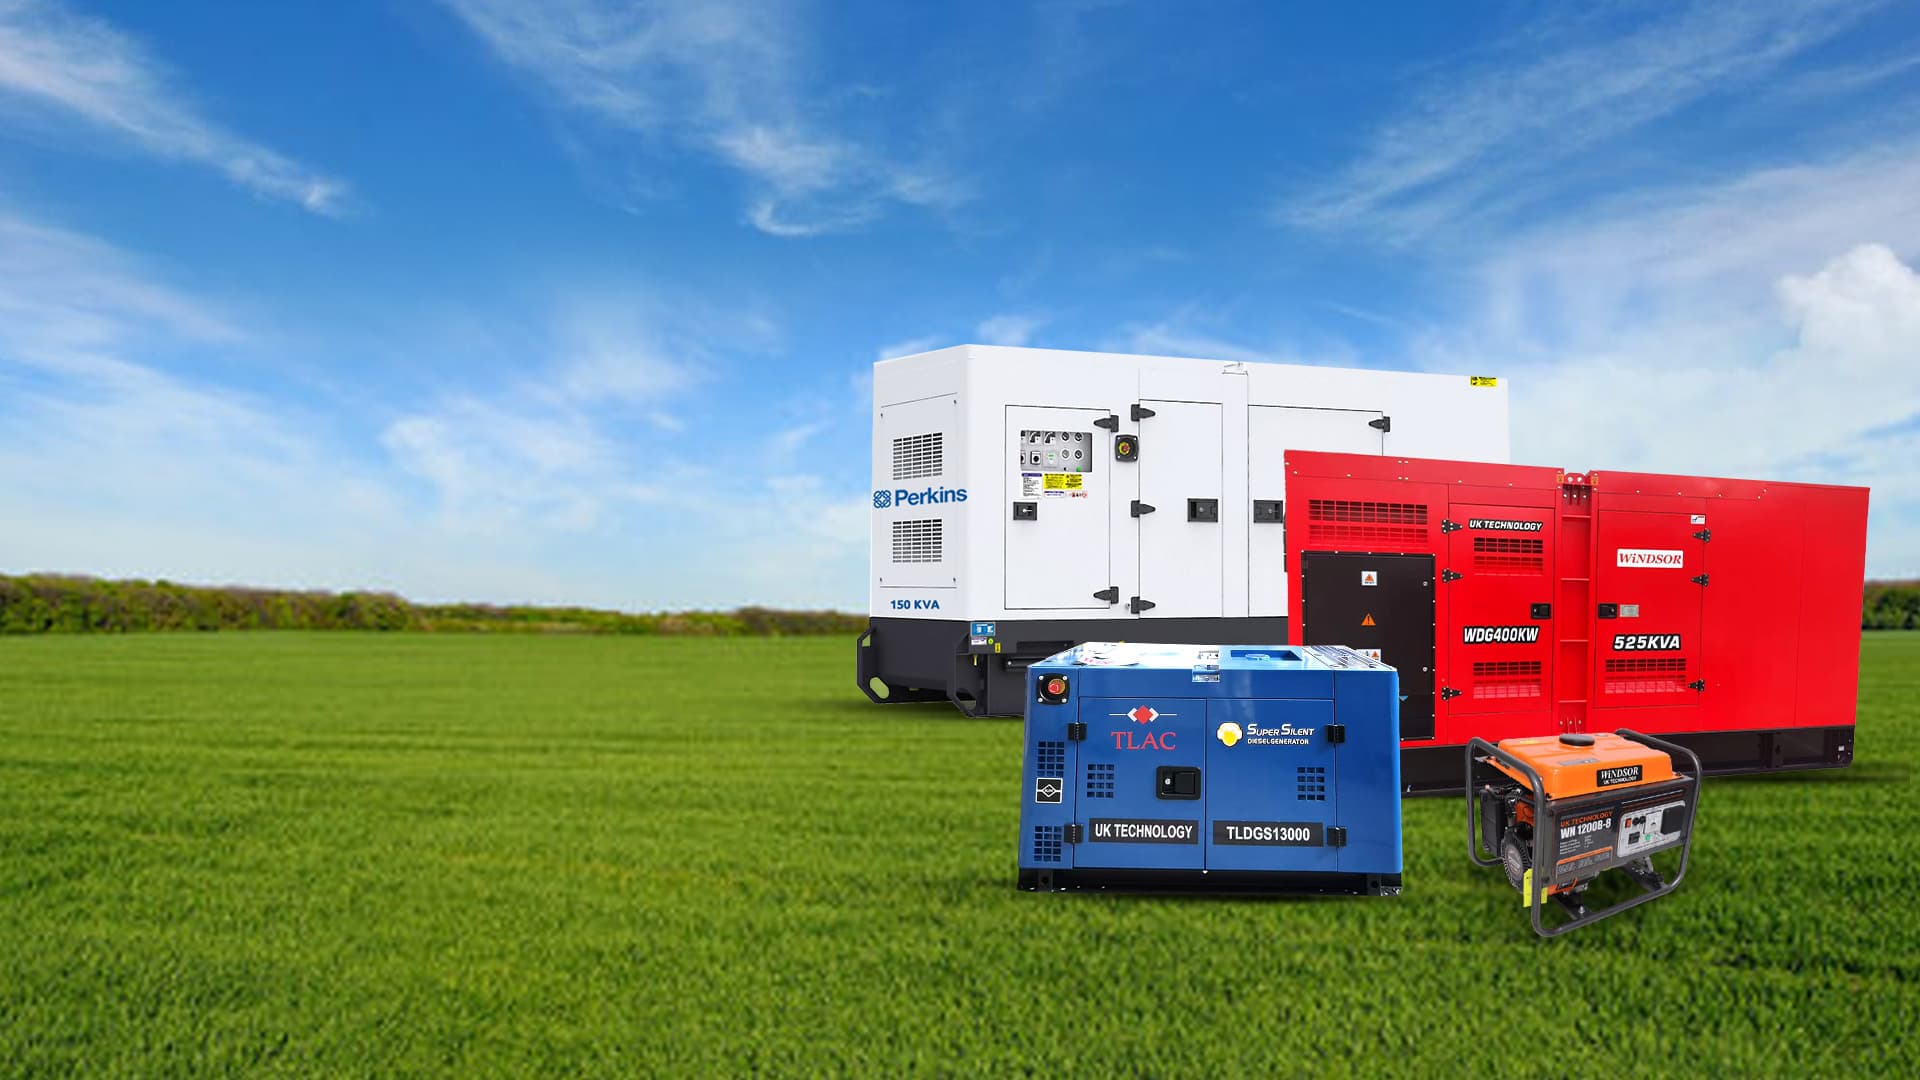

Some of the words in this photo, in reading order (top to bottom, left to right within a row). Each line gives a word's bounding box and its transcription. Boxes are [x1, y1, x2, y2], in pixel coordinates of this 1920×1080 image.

[895, 486, 968, 506] Perkins
[1469, 519, 1482, 528] UK
[1484, 520, 1542, 531] TECHNOLOGY
[890, 599, 911, 610] 150
[914, 599, 940, 610] KVA
[1464, 627, 1539, 642] WDG400KW
[1613, 635, 1680, 649] 525KVA
[1110, 731, 1177, 750] TLAC
[1095, 824, 1111, 838] UK
[1114, 824, 1193, 839] TECHNOLOGY
[1226, 826, 1310, 841] TLDGS13000
[1577, 818, 1612, 835] 1200B-8
